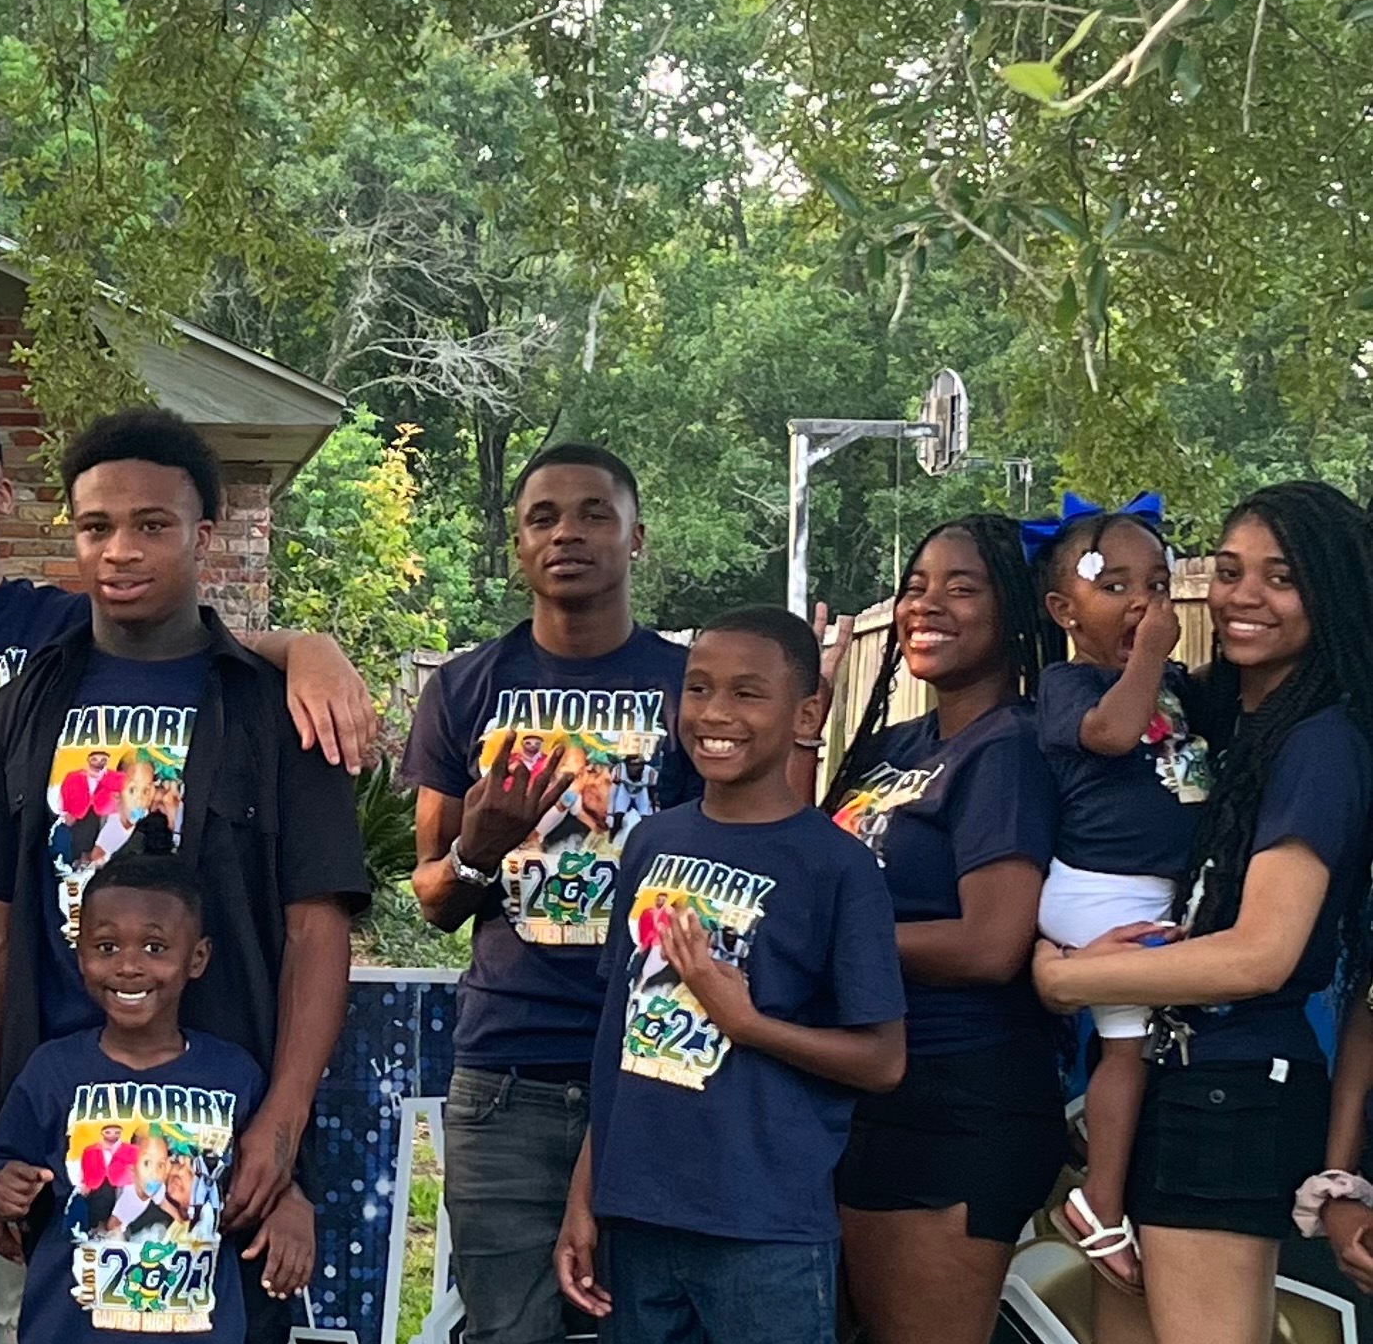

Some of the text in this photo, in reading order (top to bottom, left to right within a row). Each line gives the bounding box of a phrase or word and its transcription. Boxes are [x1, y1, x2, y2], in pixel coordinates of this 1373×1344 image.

[61, 705, 198, 748] JAVOR
[497, 689, 665, 732] JAVORRY
[647, 854, 777, 911] JAVORRY
[74, 1082, 236, 1131] JAVORRY
